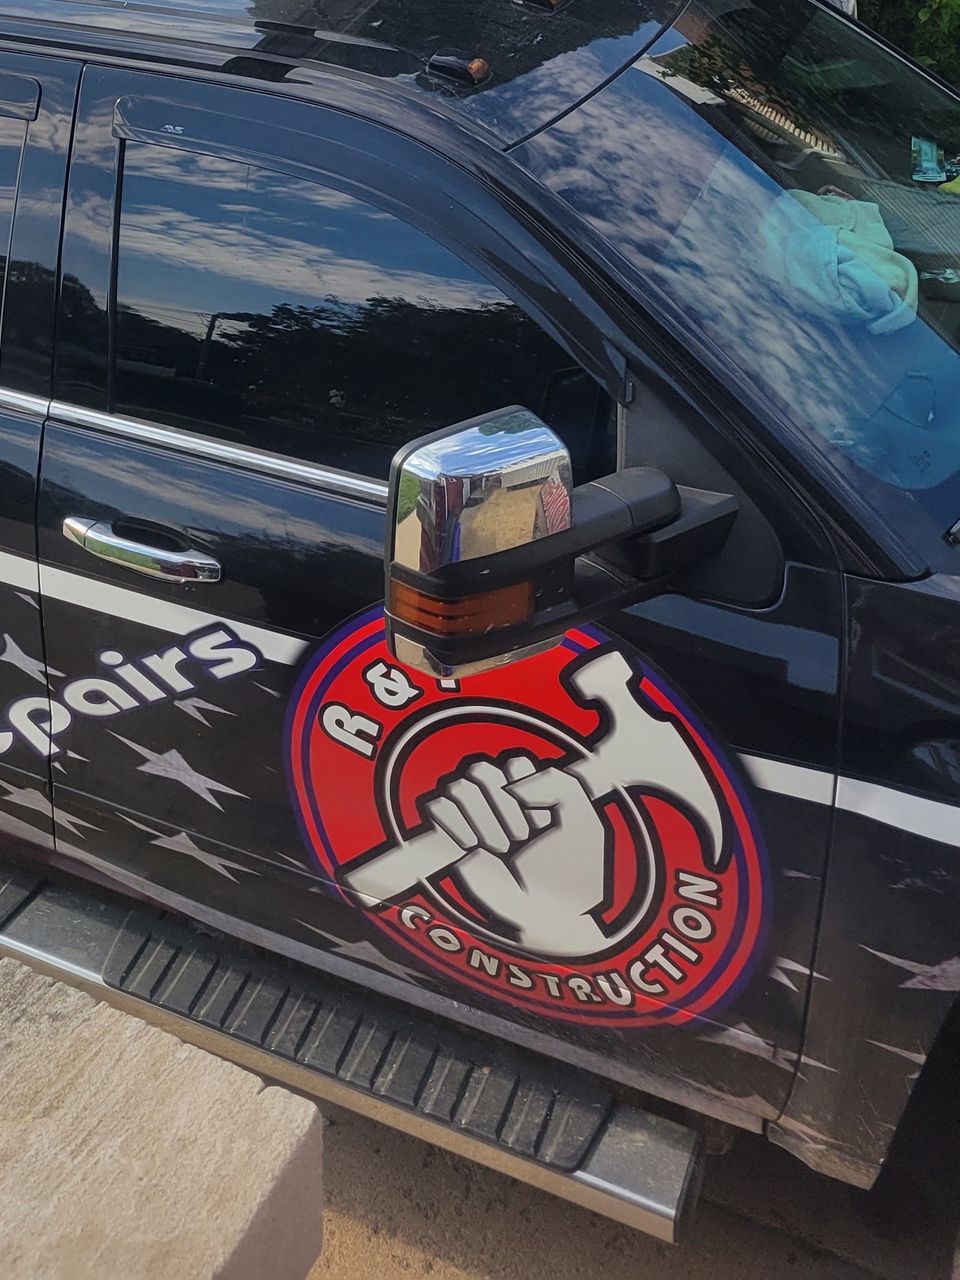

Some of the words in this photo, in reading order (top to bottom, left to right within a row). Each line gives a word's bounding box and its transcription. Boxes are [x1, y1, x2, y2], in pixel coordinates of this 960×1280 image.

[322, 703, 381, 758] R
[364, 661, 421, 708] &
[398, 871, 720, 1007] CONSTRUCTION
